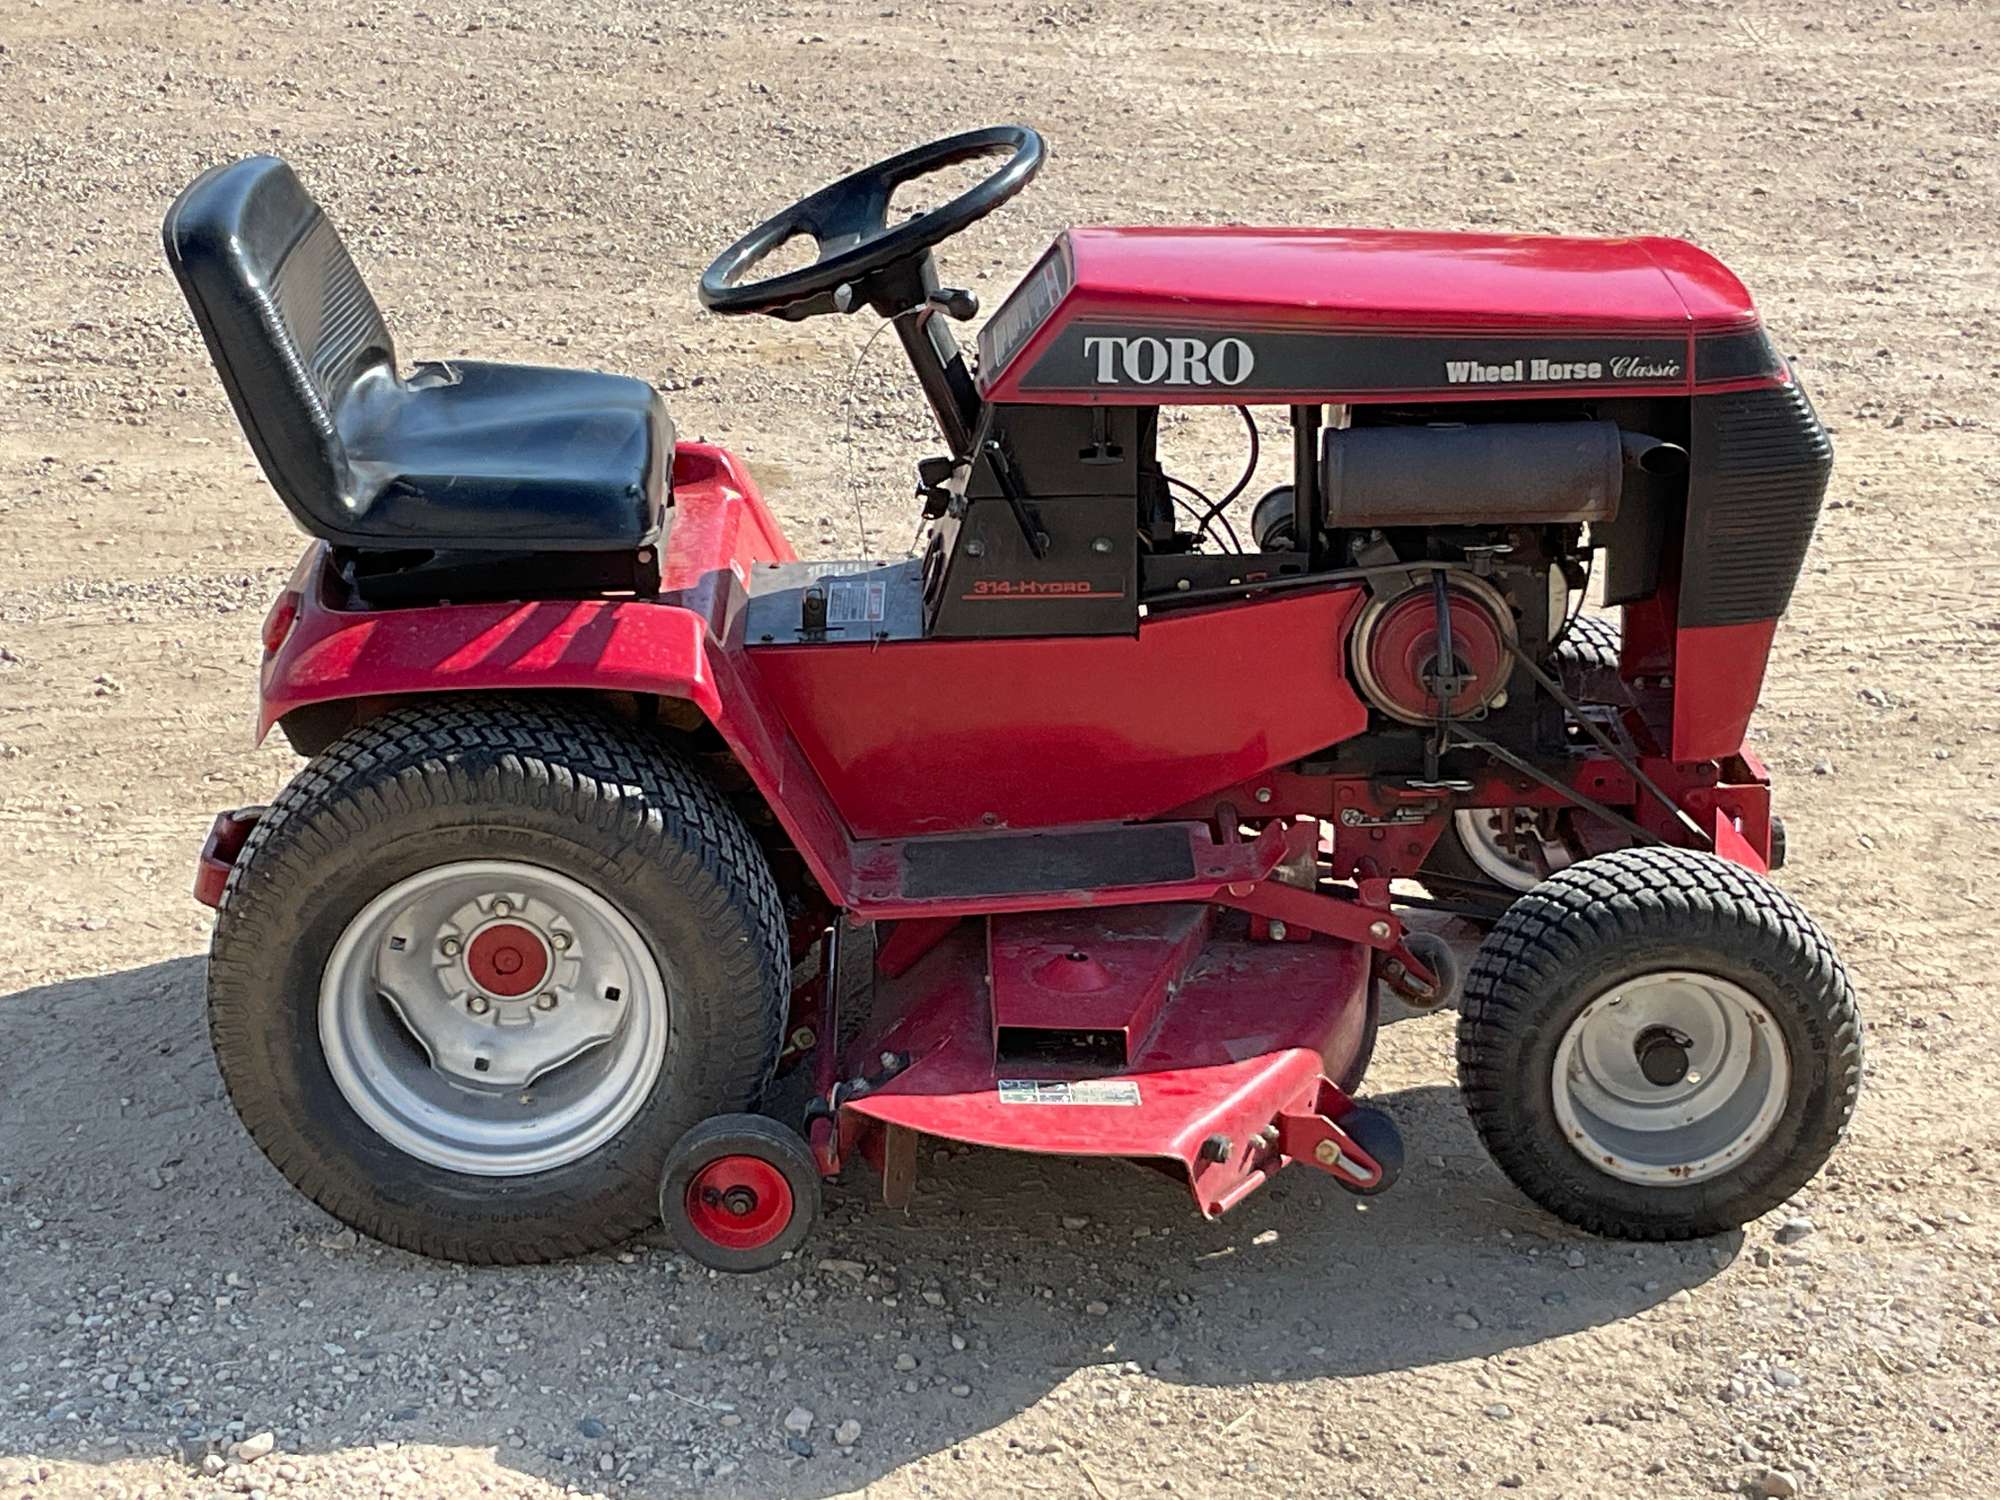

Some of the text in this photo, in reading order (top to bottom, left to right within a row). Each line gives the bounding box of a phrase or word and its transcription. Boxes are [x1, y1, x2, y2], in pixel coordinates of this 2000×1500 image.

[1084, 337, 1255, 385] TORO
[1446, 356, 1680, 383] Wheel Horse Classic
